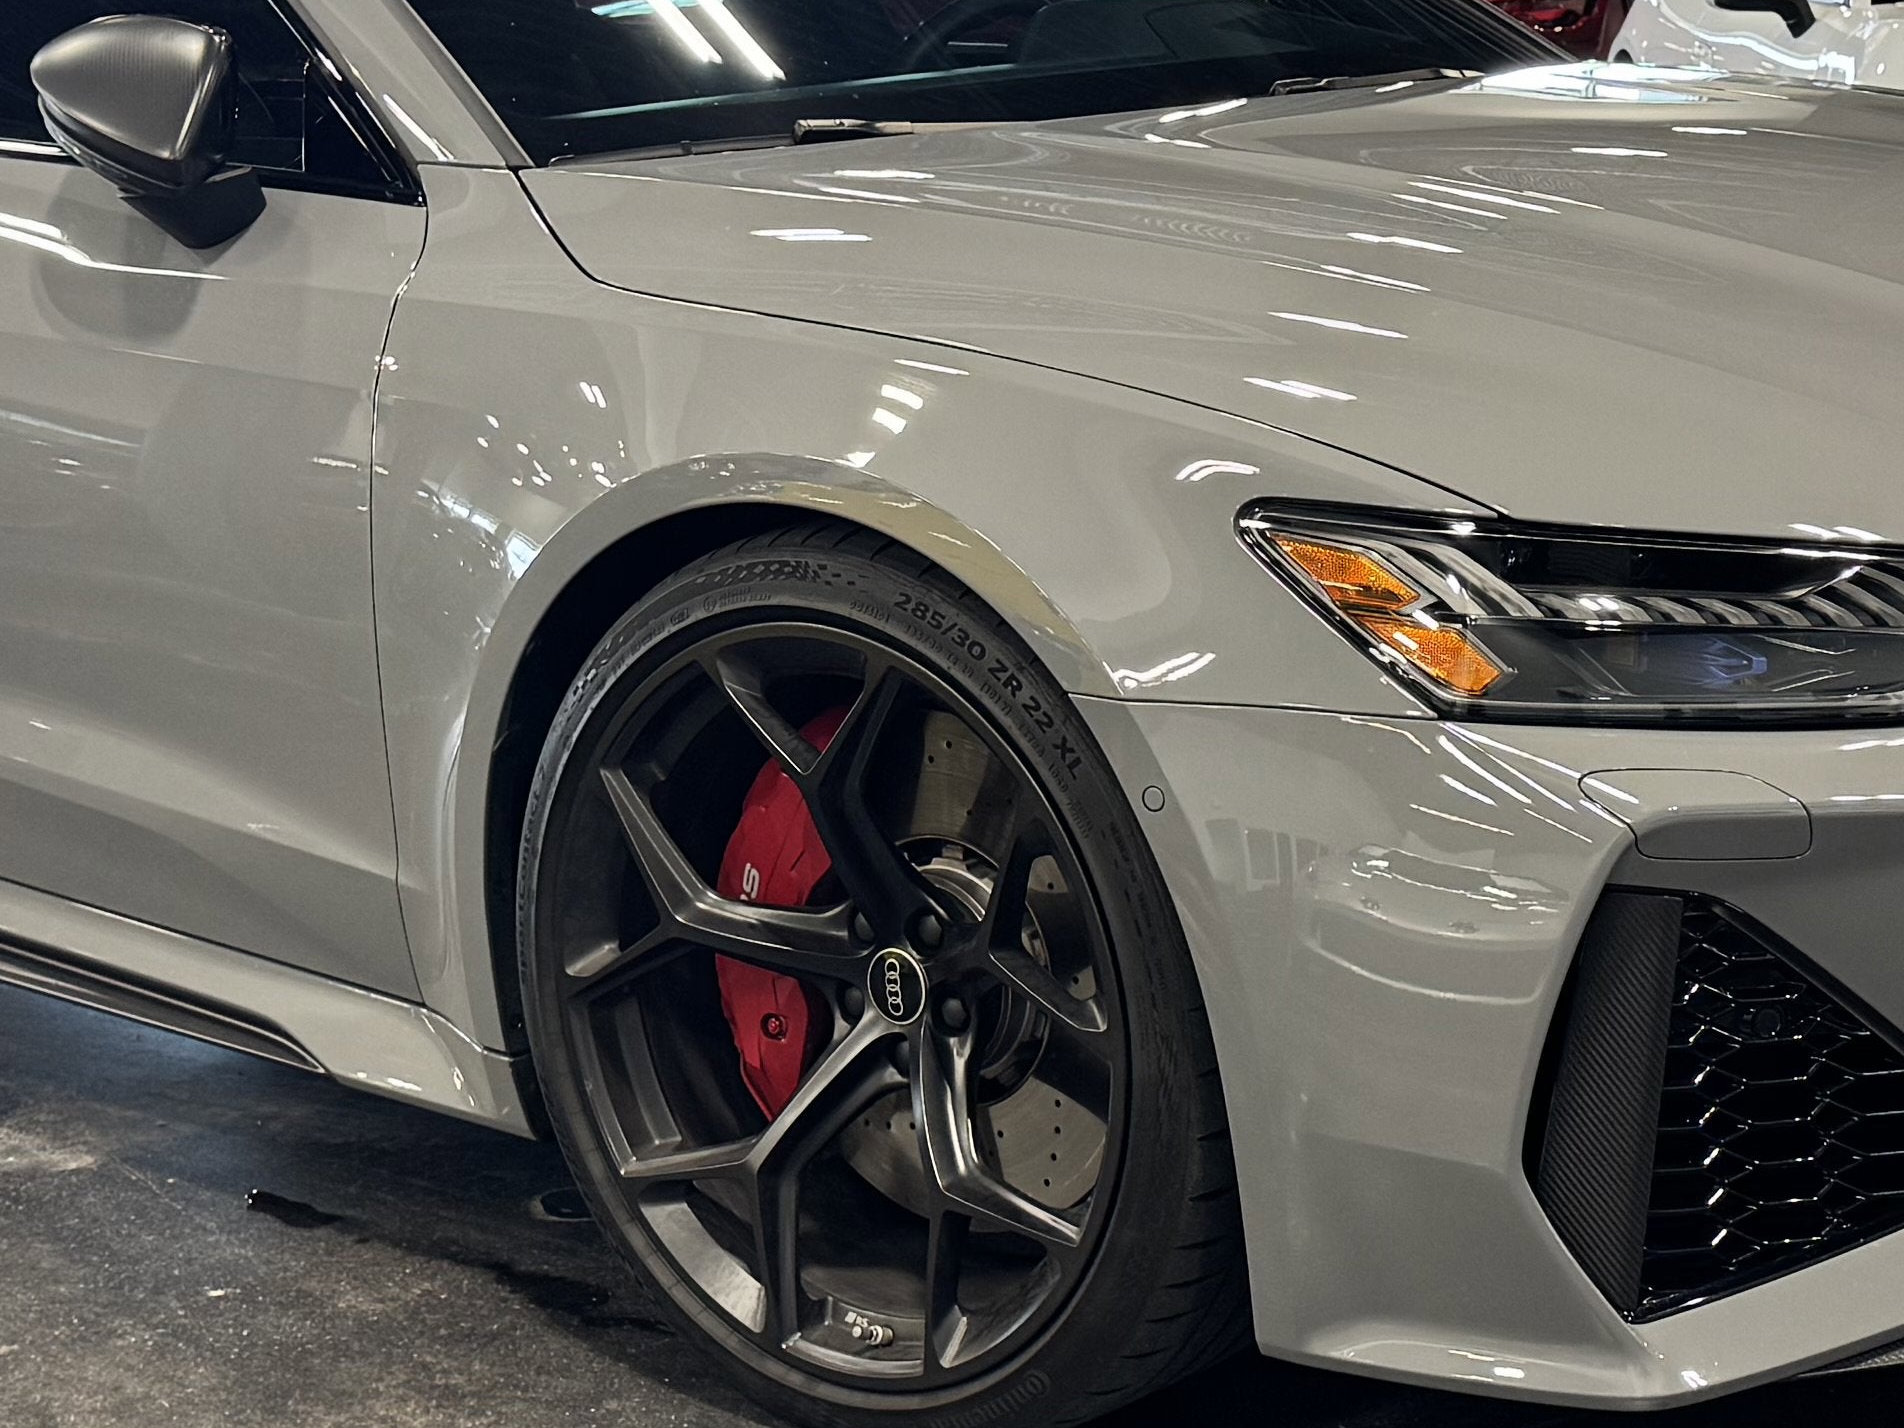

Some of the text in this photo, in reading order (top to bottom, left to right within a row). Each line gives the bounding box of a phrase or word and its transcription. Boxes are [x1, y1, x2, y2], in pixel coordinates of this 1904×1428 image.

[893, 591, 987, 662] 285/30
[987, 658, 1024, 699] ZR
[1021, 695, 1055, 735] 22
[1052, 734, 1083, 781] XL
[739, 862, 760, 900] S
